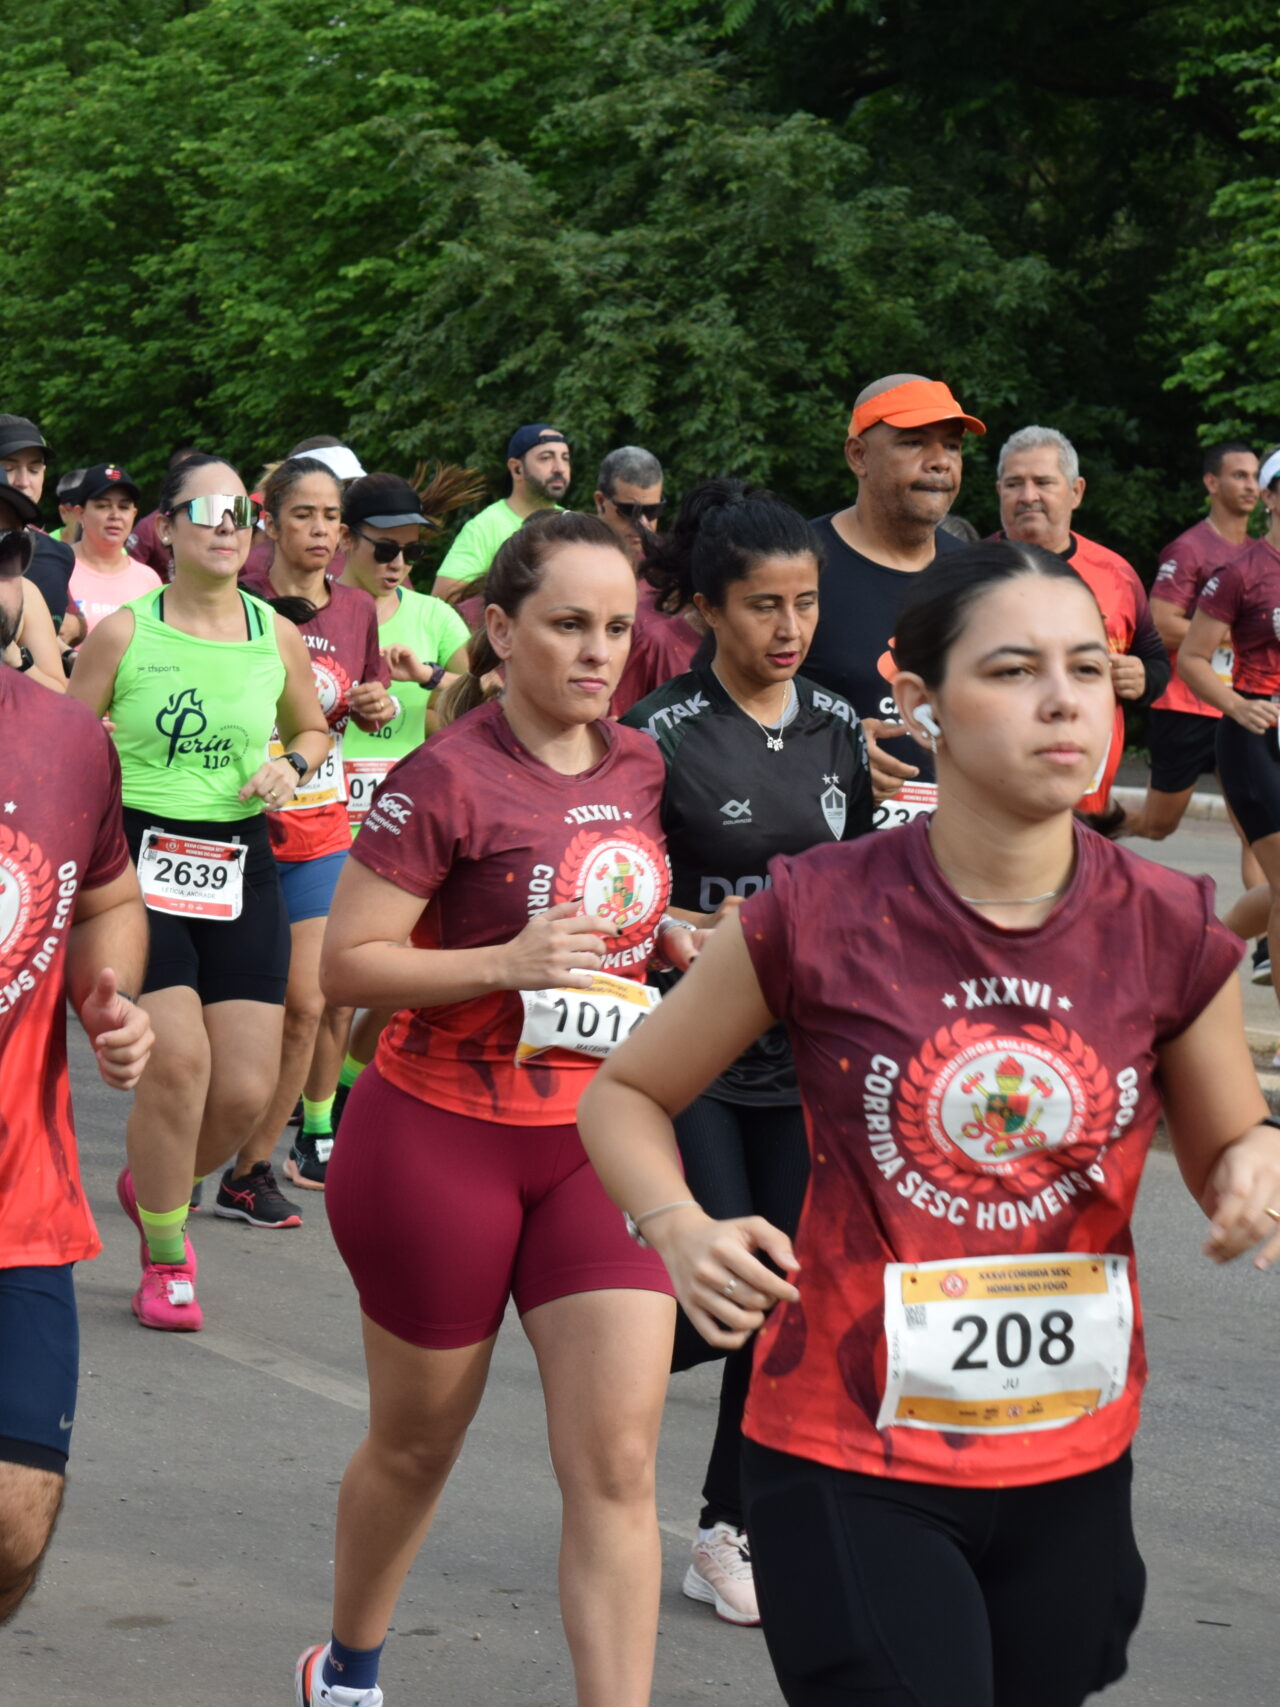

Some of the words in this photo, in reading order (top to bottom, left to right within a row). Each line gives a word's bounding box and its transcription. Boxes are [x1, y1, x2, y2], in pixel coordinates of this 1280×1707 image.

[147, 664, 180, 673] tfsports
[203, 755, 231, 770] 110
[568, 804, 621, 825] XXXVI
[154, 858, 228, 890] 2639
[959, 976, 1052, 1010] XXXVI
[997, 1039, 1053, 1060] MILITAR
[863, 1053, 906, 1180] CORRIDA
[897, 1170, 969, 1225] SESC
[976, 1171, 1091, 1231] HOMENS
[1008, 1268, 1050, 1279] CORRIDA
[987, 1283, 1026, 1294] HOMENS
[1028, 1282, 1041, 1292] DO
[1043, 1281, 1068, 1291] FOGO
[951, 1310, 1075, 1371] 208
